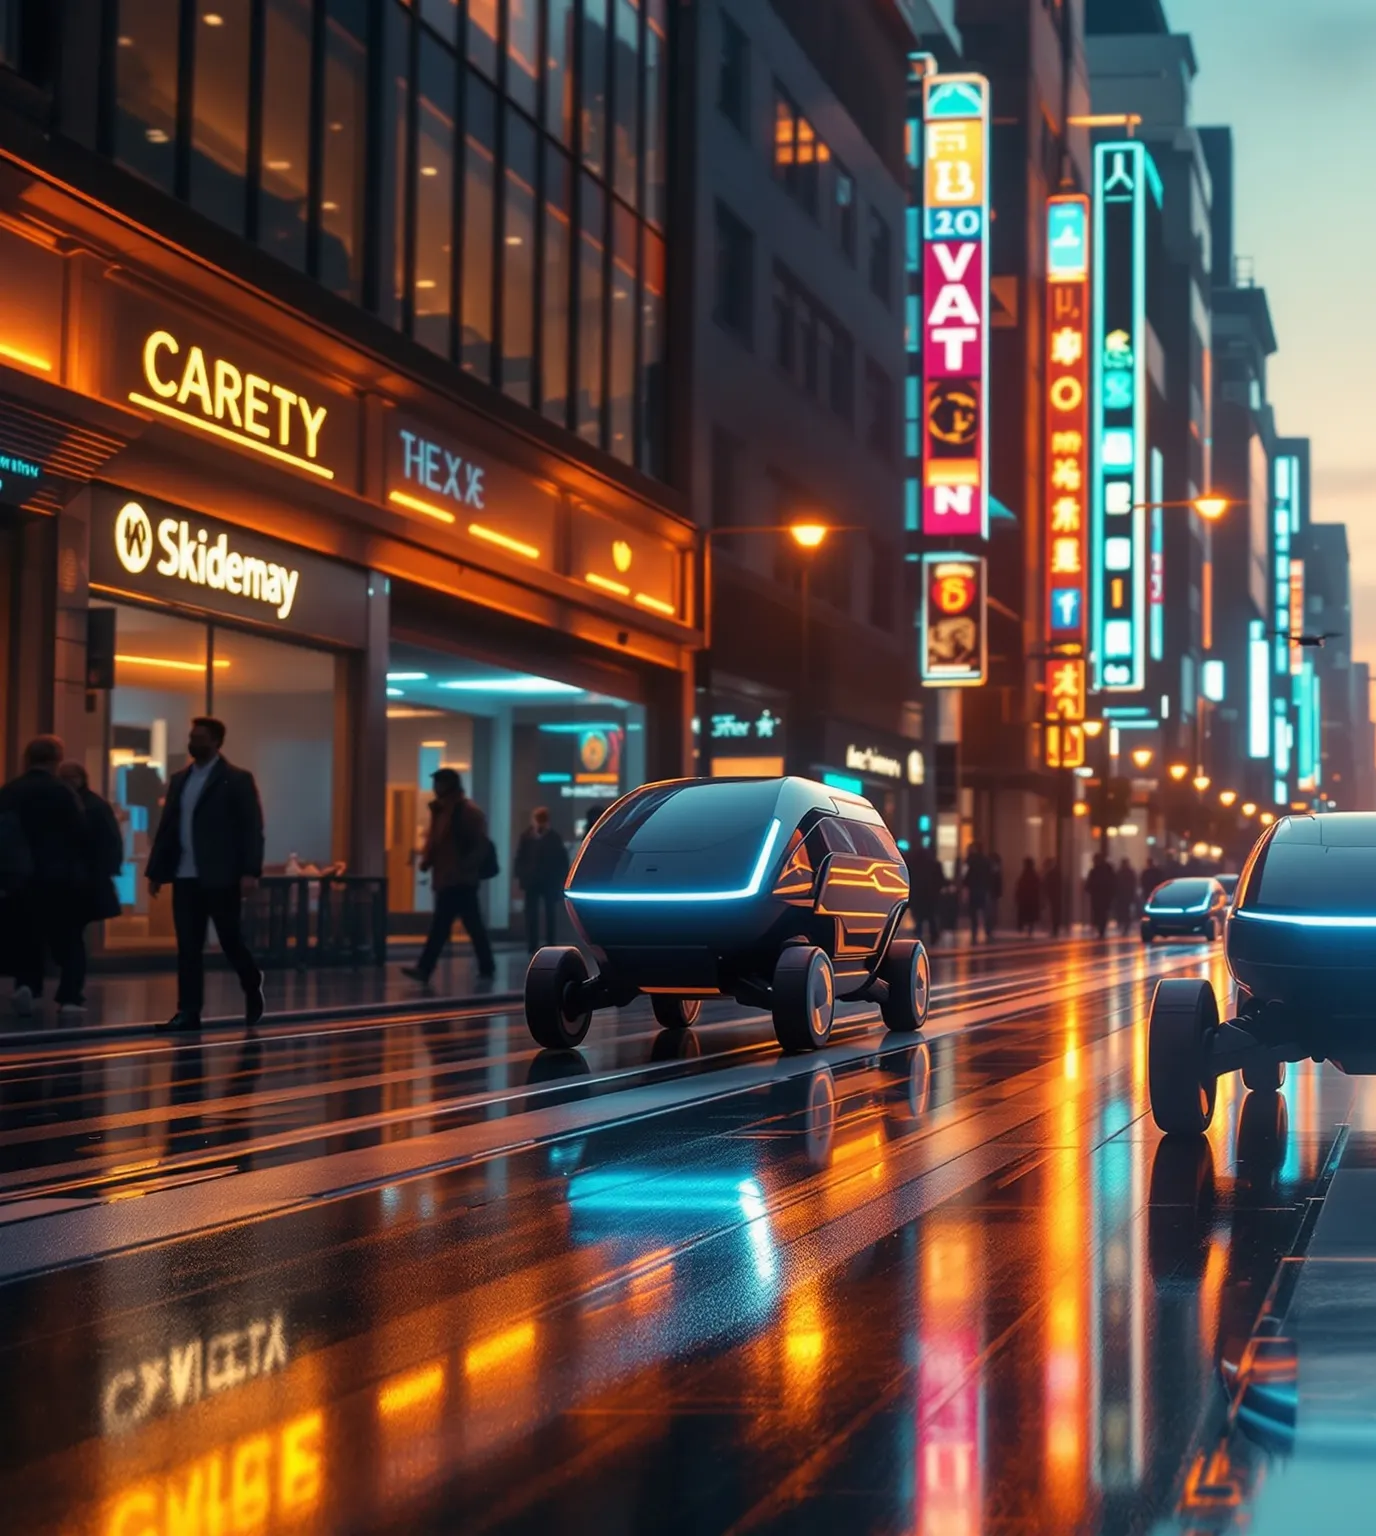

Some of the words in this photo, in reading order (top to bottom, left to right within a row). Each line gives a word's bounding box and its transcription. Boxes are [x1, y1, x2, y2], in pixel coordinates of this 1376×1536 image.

[933, 209, 981, 237] 20
[143, 329, 328, 458] CARETY
[156, 517, 300, 620] Skidemay
